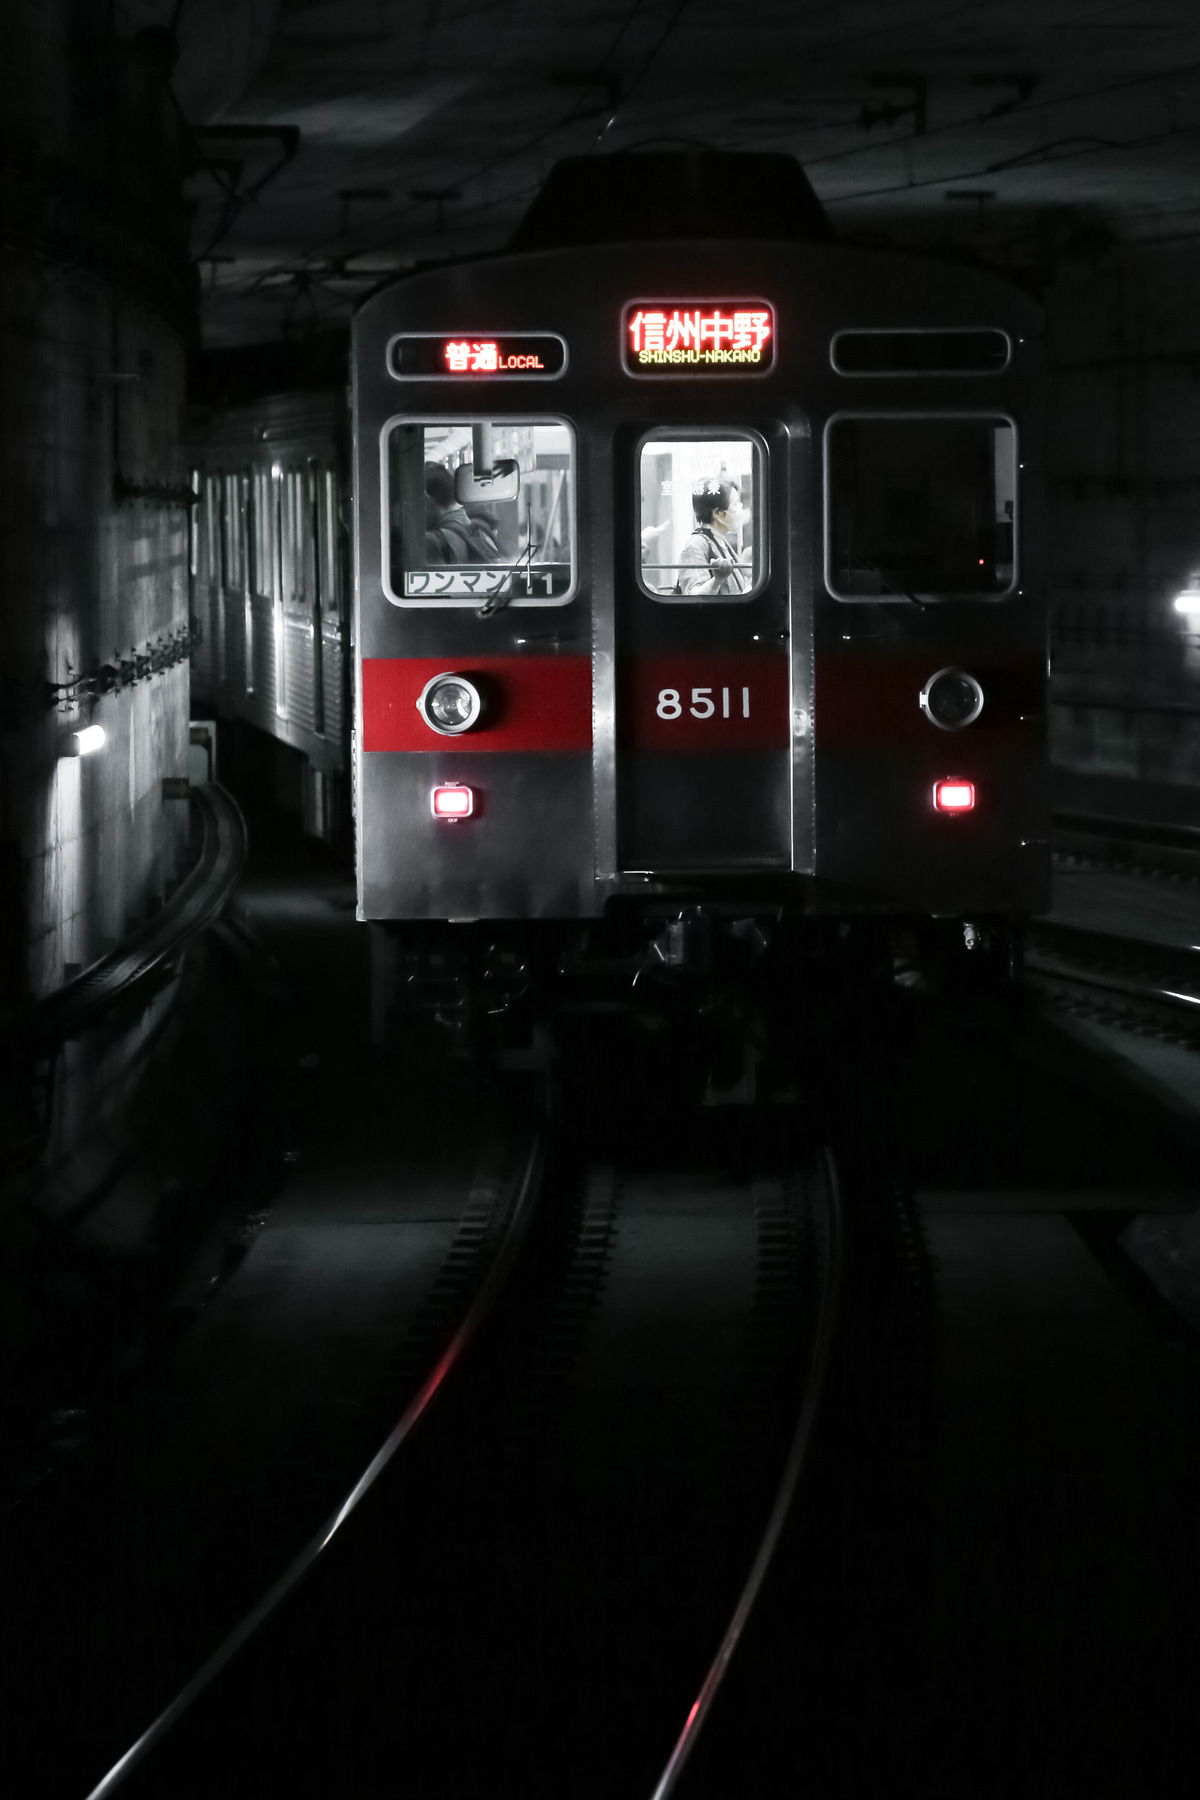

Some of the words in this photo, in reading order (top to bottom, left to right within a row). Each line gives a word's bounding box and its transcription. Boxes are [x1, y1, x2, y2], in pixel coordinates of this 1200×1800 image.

[630, 311, 770, 351] 信州中野
[446, 342, 498, 371] 普通
[499, 355, 544, 369] LOCAL
[639, 350, 761, 364] SHINSHU-NAKANO
[410, 572, 507, 593] ワンマン
[656, 687, 750, 720] 8511
